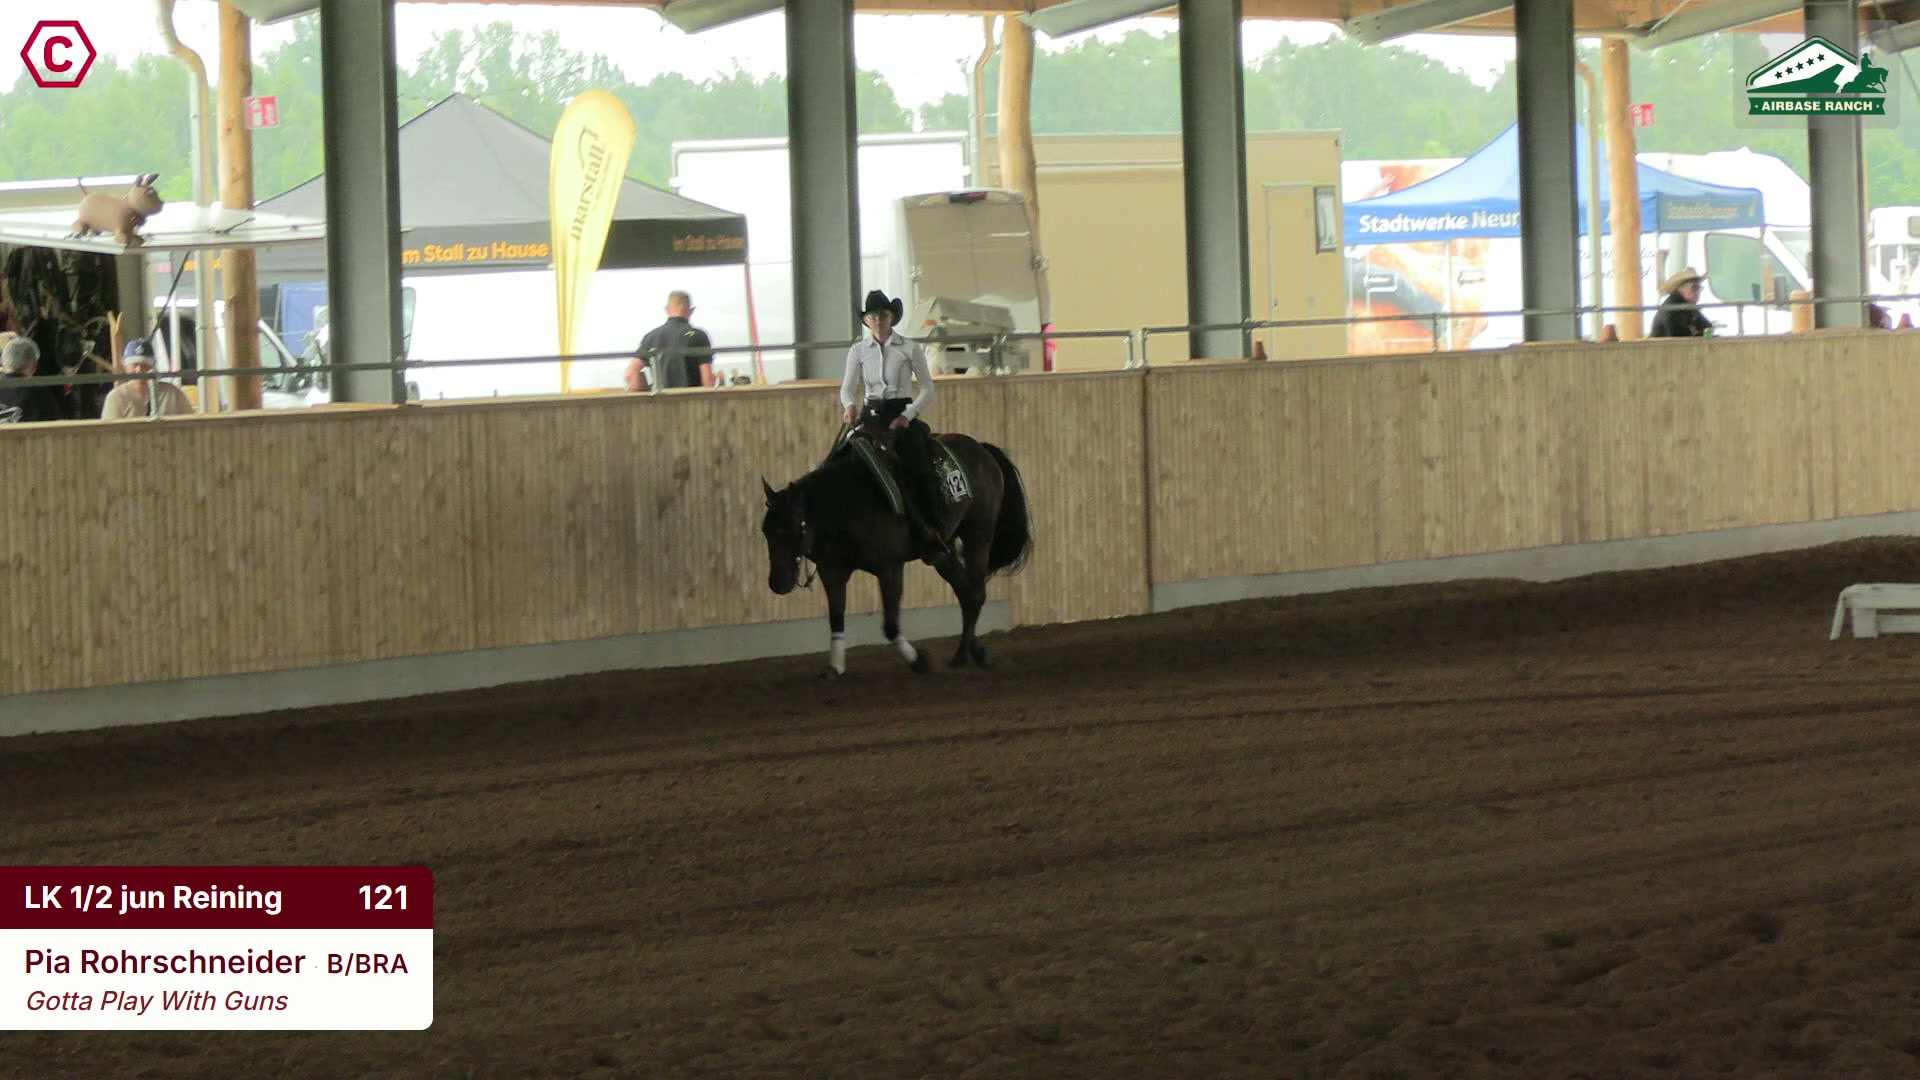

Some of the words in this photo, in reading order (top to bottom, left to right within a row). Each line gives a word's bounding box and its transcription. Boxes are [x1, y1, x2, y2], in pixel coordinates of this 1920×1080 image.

[570, 144, 606, 240] marstall
[1359, 211, 1470, 233] Stadtwerke
[1472, 210, 1521, 229] Neur
[402, 249, 421, 264] m
[423, 243, 465, 263] Stall
[467, 245, 489, 260] zu
[492, 241, 549, 260] Hause
